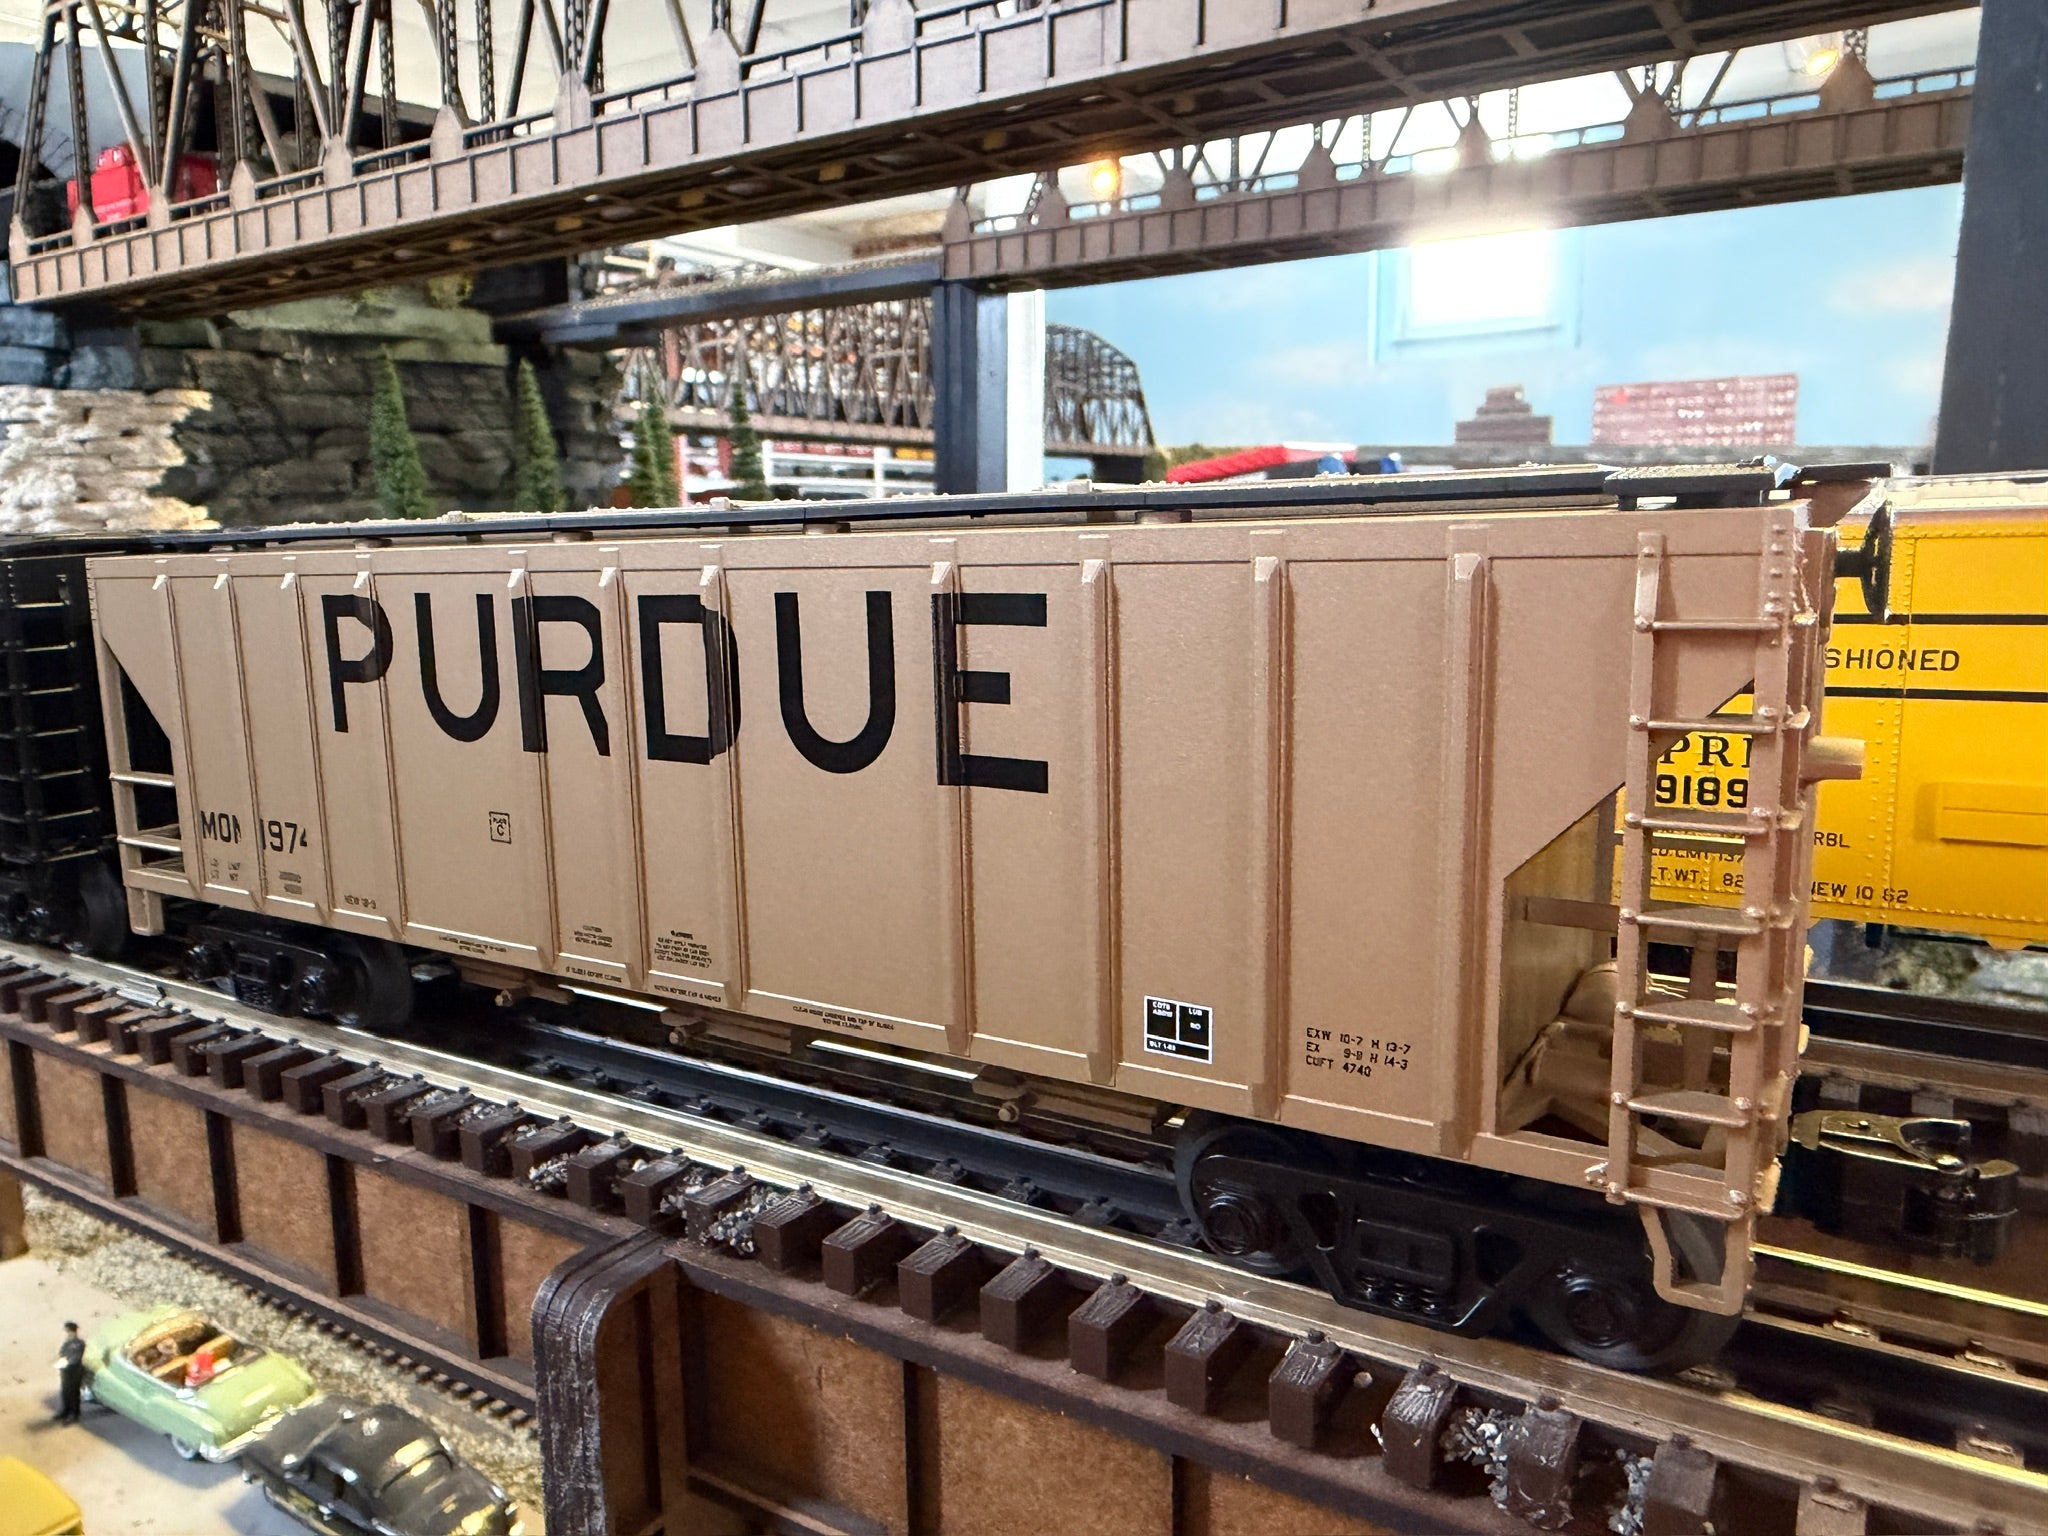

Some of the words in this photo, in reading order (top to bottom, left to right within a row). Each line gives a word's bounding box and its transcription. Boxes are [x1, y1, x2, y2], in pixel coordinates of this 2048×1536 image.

[1824, 648, 1960, 671] SHIONED
[321, 590, 1049, 794] PURDUE
[1655, 774, 1749, 808] 9189
[1813, 831, 1850, 848] RBL
[1856, 884, 1873, 900] 10
[1306, 1027, 1332, 1041] EXW
[1340, 1033, 1364, 1046] 10-7
[1371, 1039, 1380, 1050] H
[1386, 1042, 1411, 1055] 13-7
[1306, 1041, 1320, 1053] EX
[1369, 1053, 1378, 1064] H
[1384, 1055, 1409, 1071] 14-3
